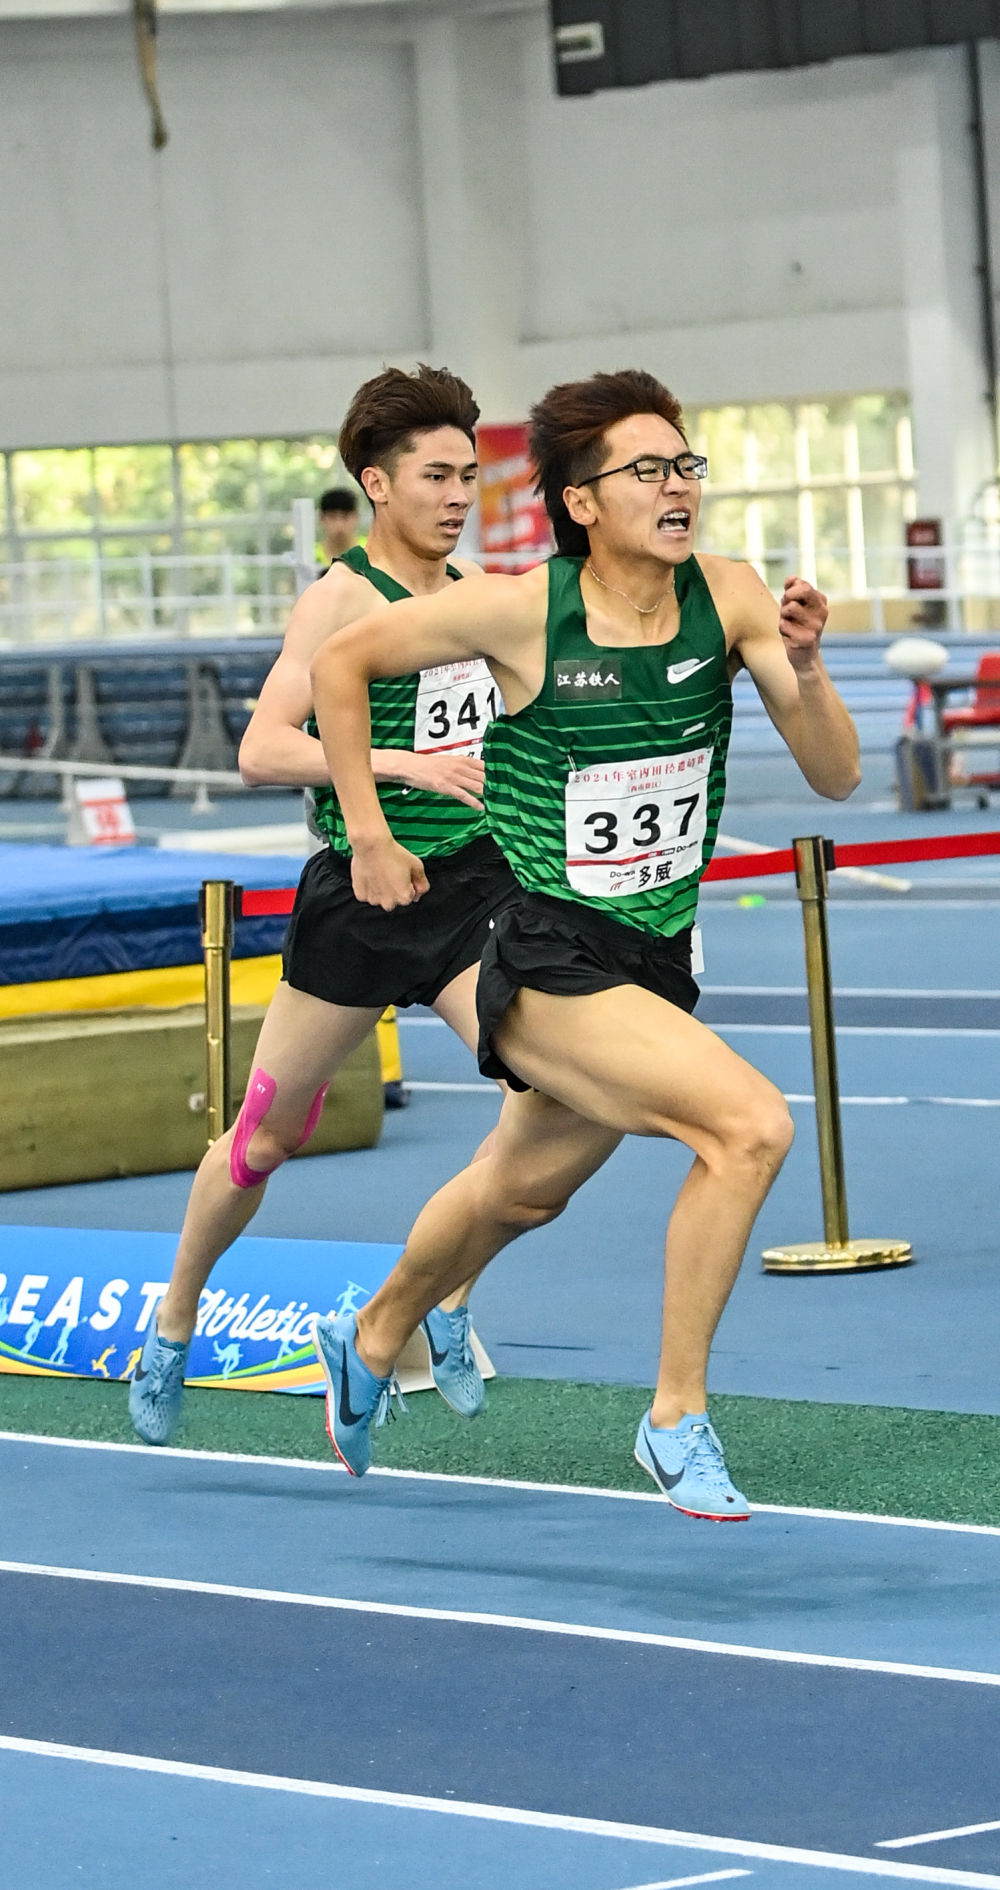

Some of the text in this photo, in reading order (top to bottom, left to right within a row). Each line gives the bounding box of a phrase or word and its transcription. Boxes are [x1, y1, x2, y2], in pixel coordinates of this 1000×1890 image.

[557, 671, 620, 688] 江苏铁人
[428, 687, 496, 739] 341
[584, 793, 699, 854] 337
[638, 860, 673, 888] 多威
[0, 1273, 337, 1344] EAST Athletic
